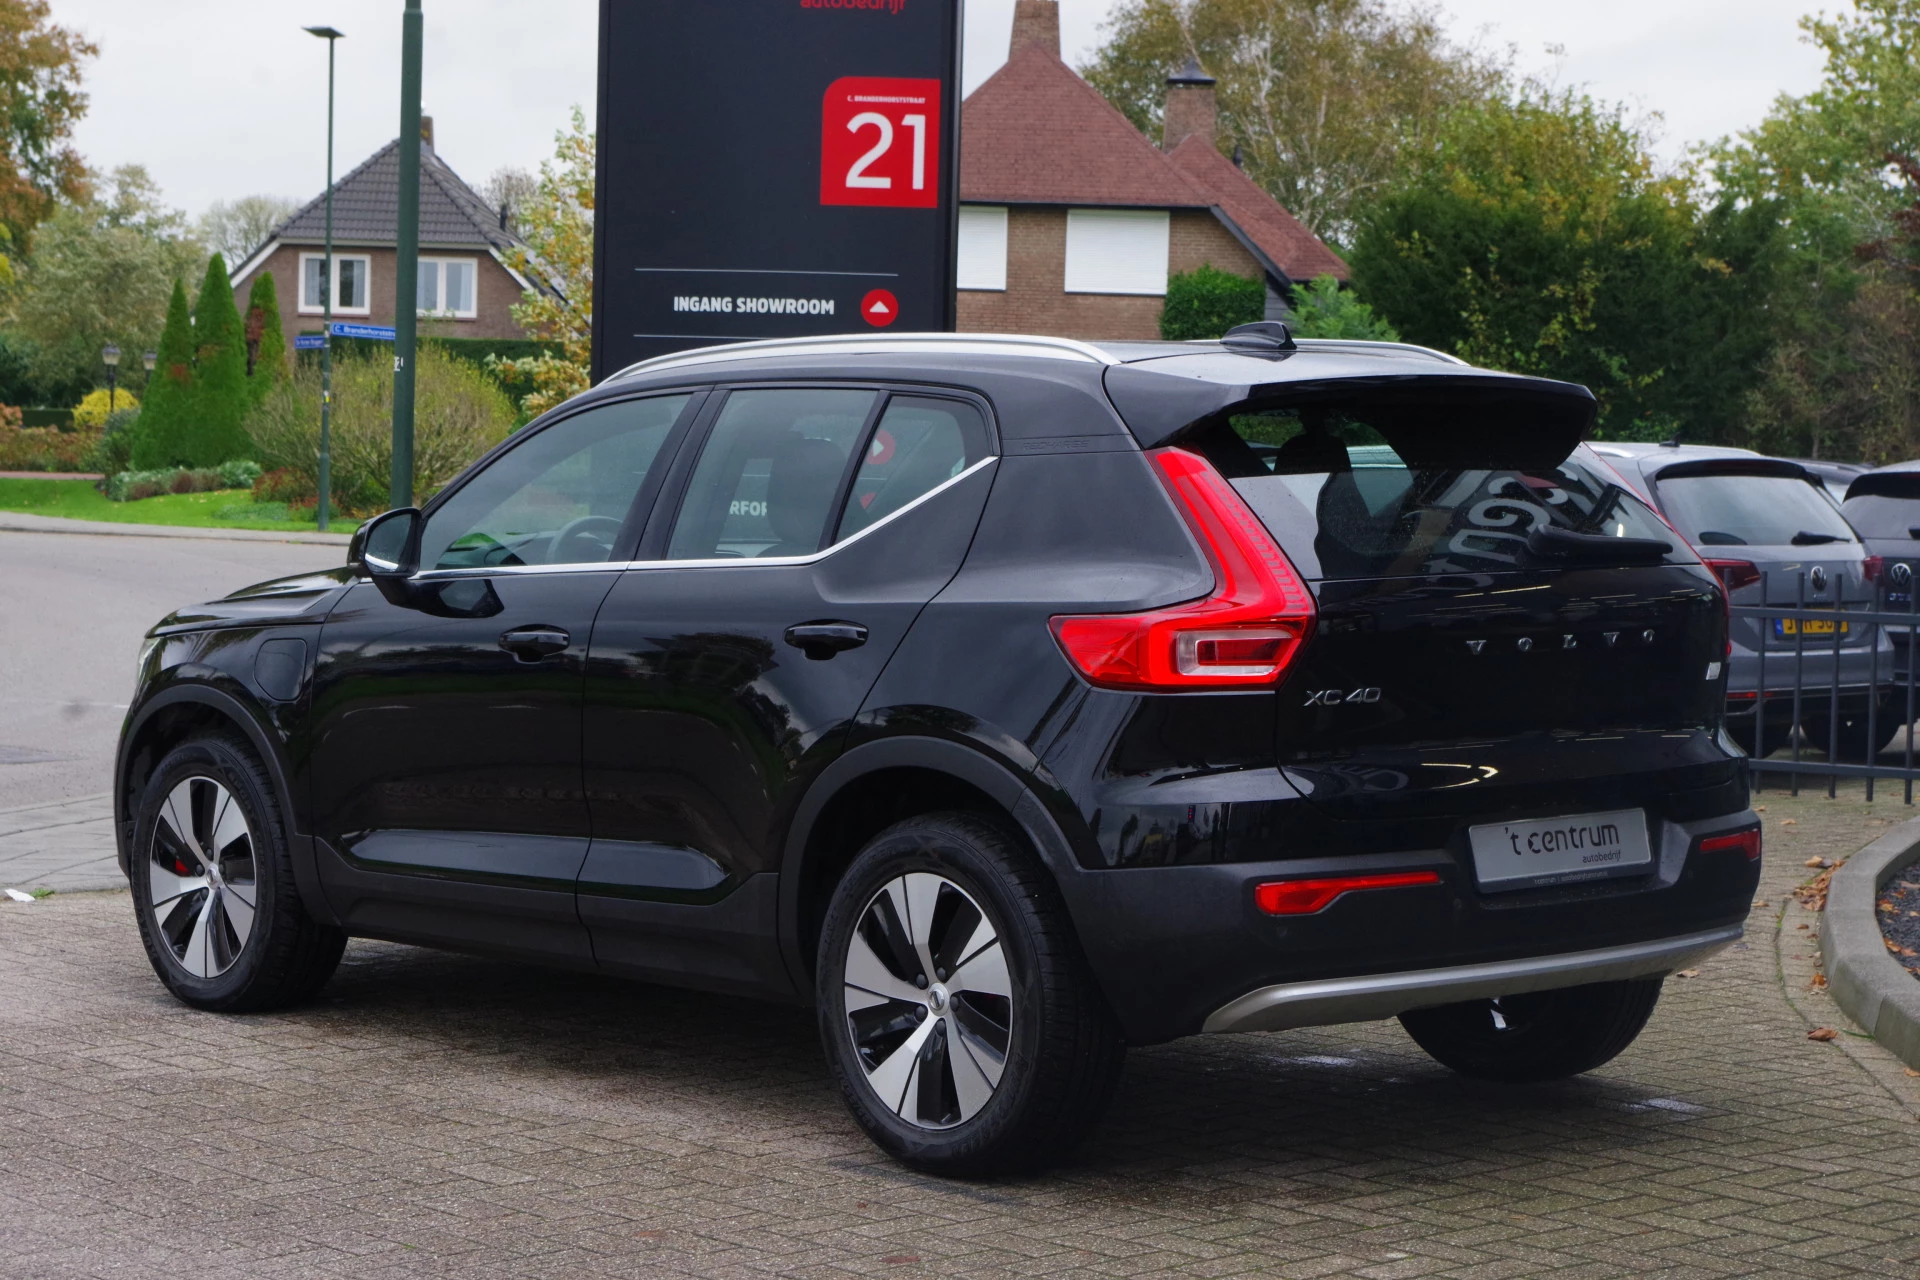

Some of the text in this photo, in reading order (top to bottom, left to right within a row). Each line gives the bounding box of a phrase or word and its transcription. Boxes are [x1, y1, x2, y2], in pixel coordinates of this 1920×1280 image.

[845, 111, 926, 190] 21
[673, 296, 835, 315] INGANG SHOWROOM
[1466, 629, 1655, 655] VOLVO
[1527, 824, 1620, 854] centrum
[1582, 849, 1621, 864] autobedrijf
